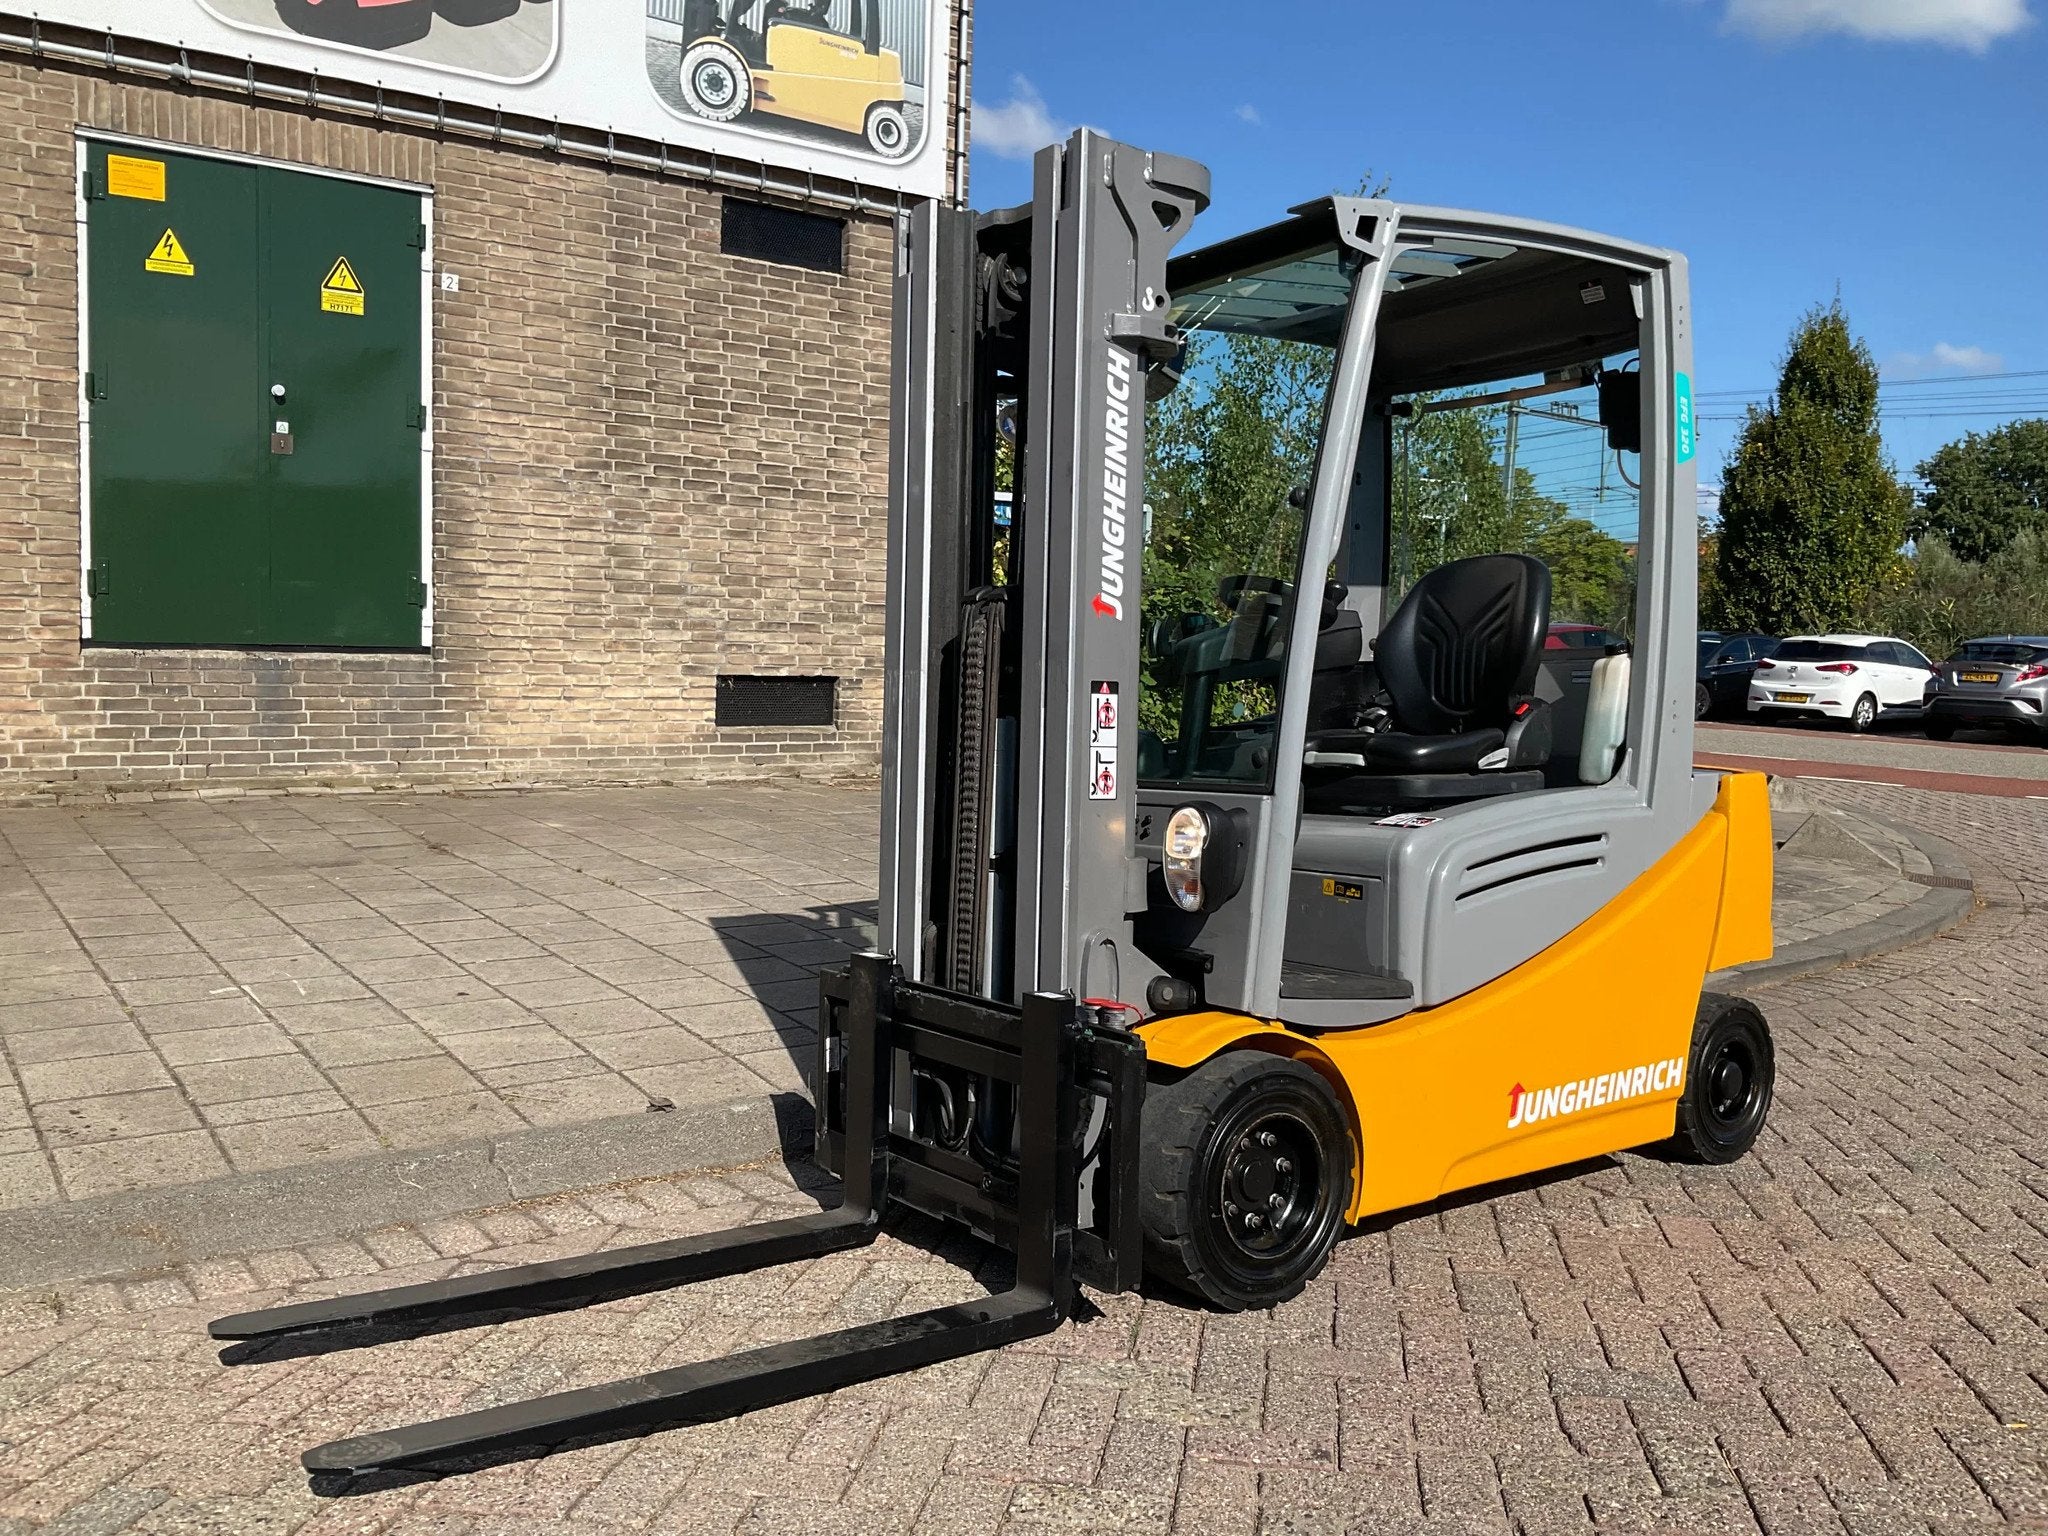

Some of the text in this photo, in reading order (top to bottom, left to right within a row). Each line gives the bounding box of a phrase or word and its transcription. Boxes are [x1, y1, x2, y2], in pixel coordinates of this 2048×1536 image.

[330, 303, 353, 313] H7171
[446, 275, 454, 290] 2
[1680, 395, 1690, 455] EFG 320
[1098, 347, 1130, 622] JUNGHEINRICH
[1507, 1056, 1684, 1129] JUNGHEINRICH
